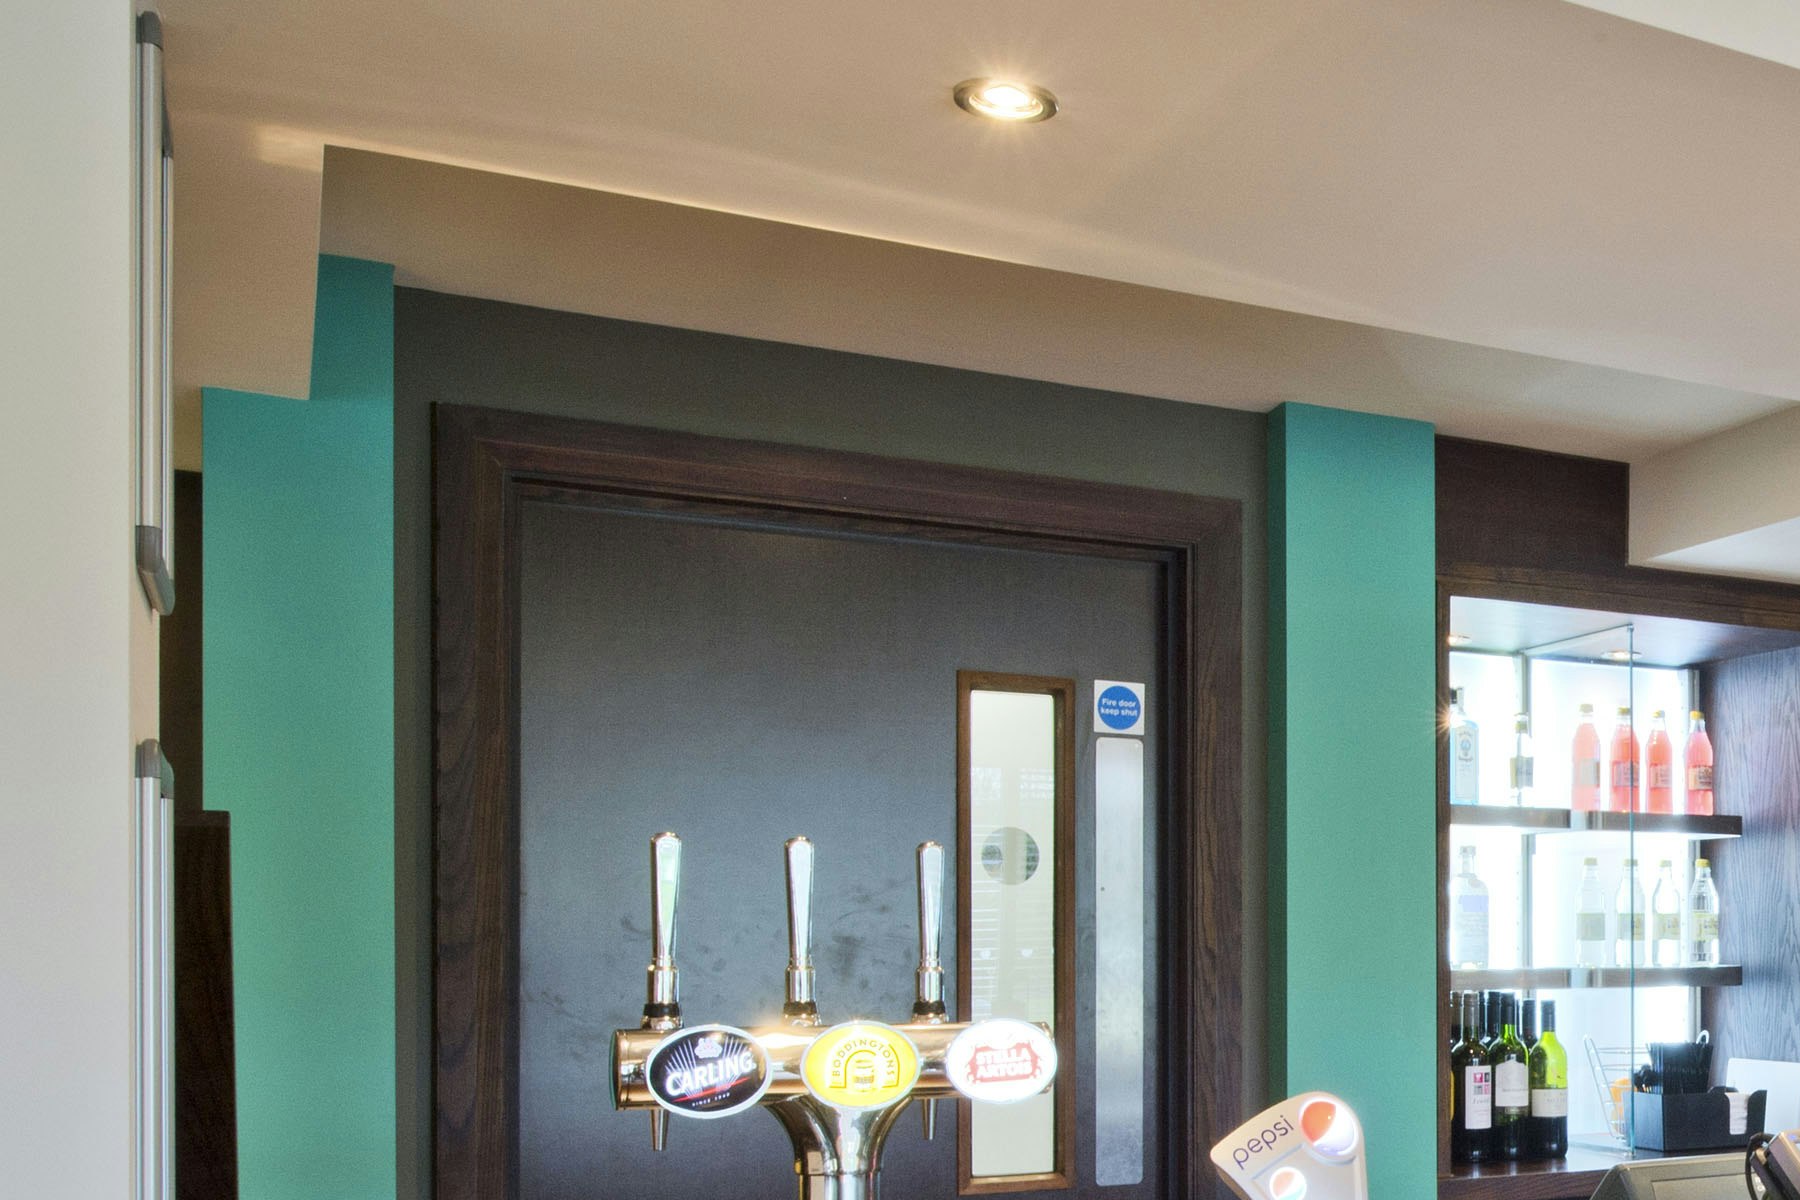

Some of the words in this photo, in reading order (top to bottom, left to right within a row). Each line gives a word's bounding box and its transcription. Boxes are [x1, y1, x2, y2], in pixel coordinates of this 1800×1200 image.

[1102, 698, 1117, 706] Fire
[1119, 699, 1137, 707] door
[1101, 707, 1120, 716] keep
[1121, 709, 1138, 717] shut
[832, 1039, 895, 1077] BODDINGTONS
[975, 1047, 1031, 1065] STELLA
[665, 1051, 753, 1096] CARLING
[975, 1061, 1032, 1078] ARTOIS
[1233, 1115, 1294, 1170] pepsi
